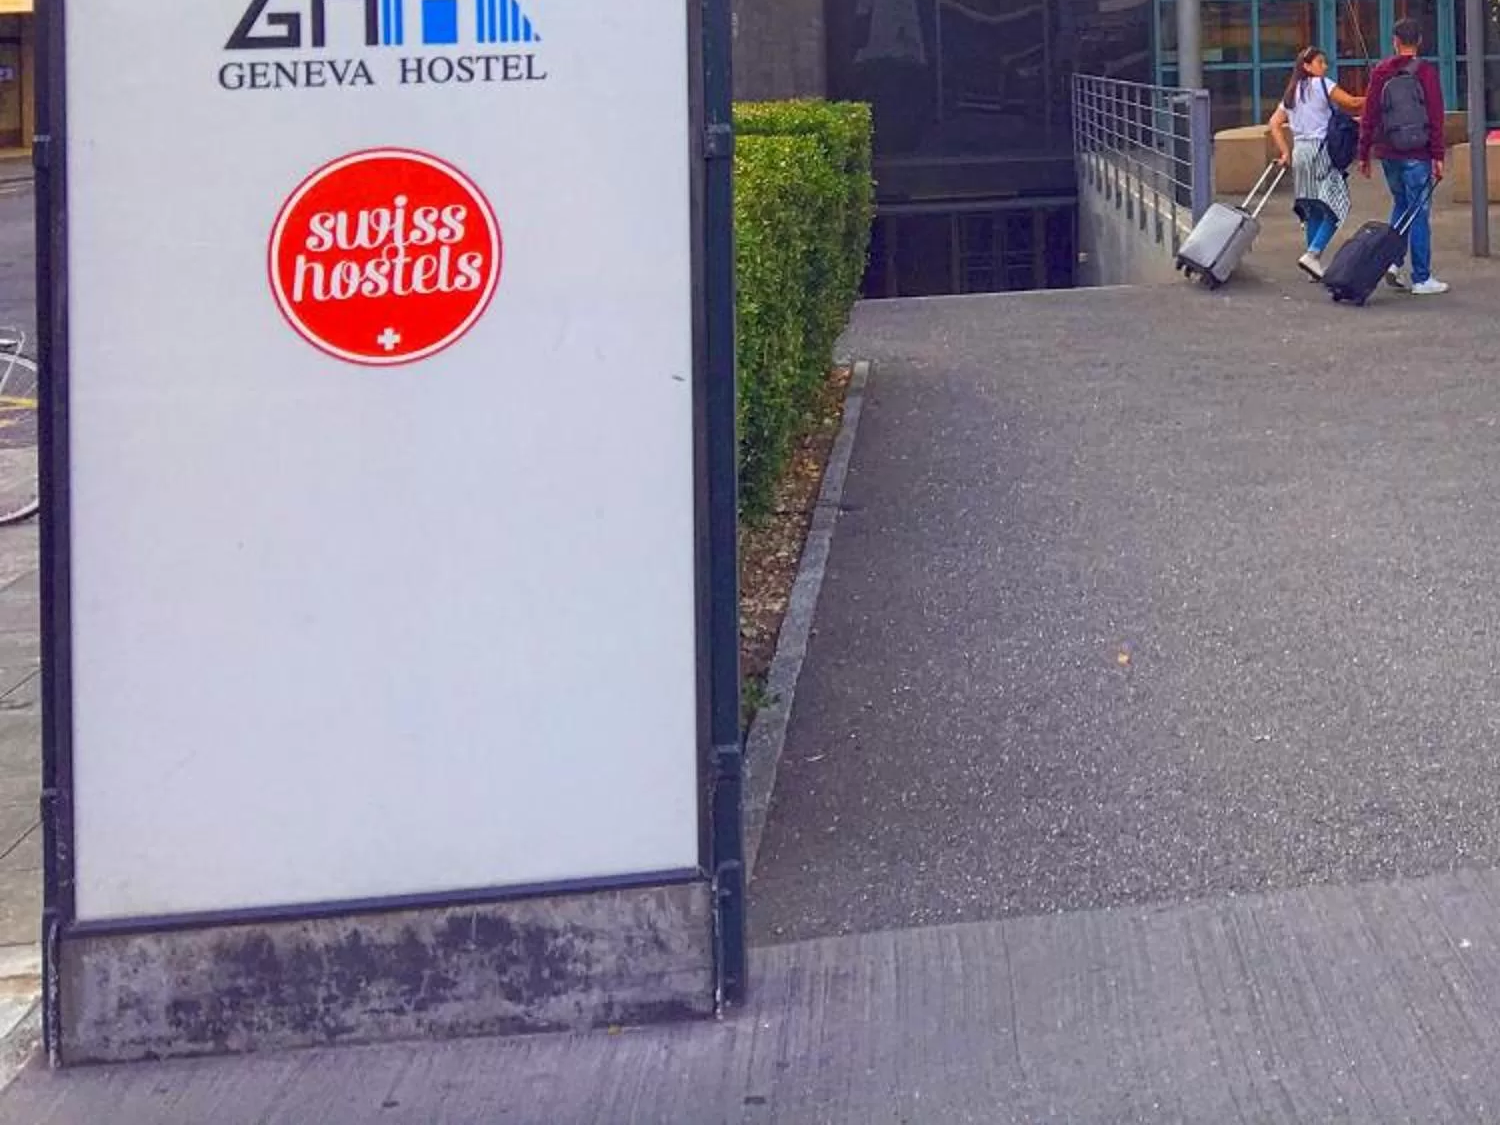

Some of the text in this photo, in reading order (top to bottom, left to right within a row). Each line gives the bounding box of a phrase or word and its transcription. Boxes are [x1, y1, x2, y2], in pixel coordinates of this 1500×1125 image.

[218, 54, 547, 90] GENEVA HOSTEL
[305, 194, 467, 253] swiss
[291, 246, 484, 303] hostels
